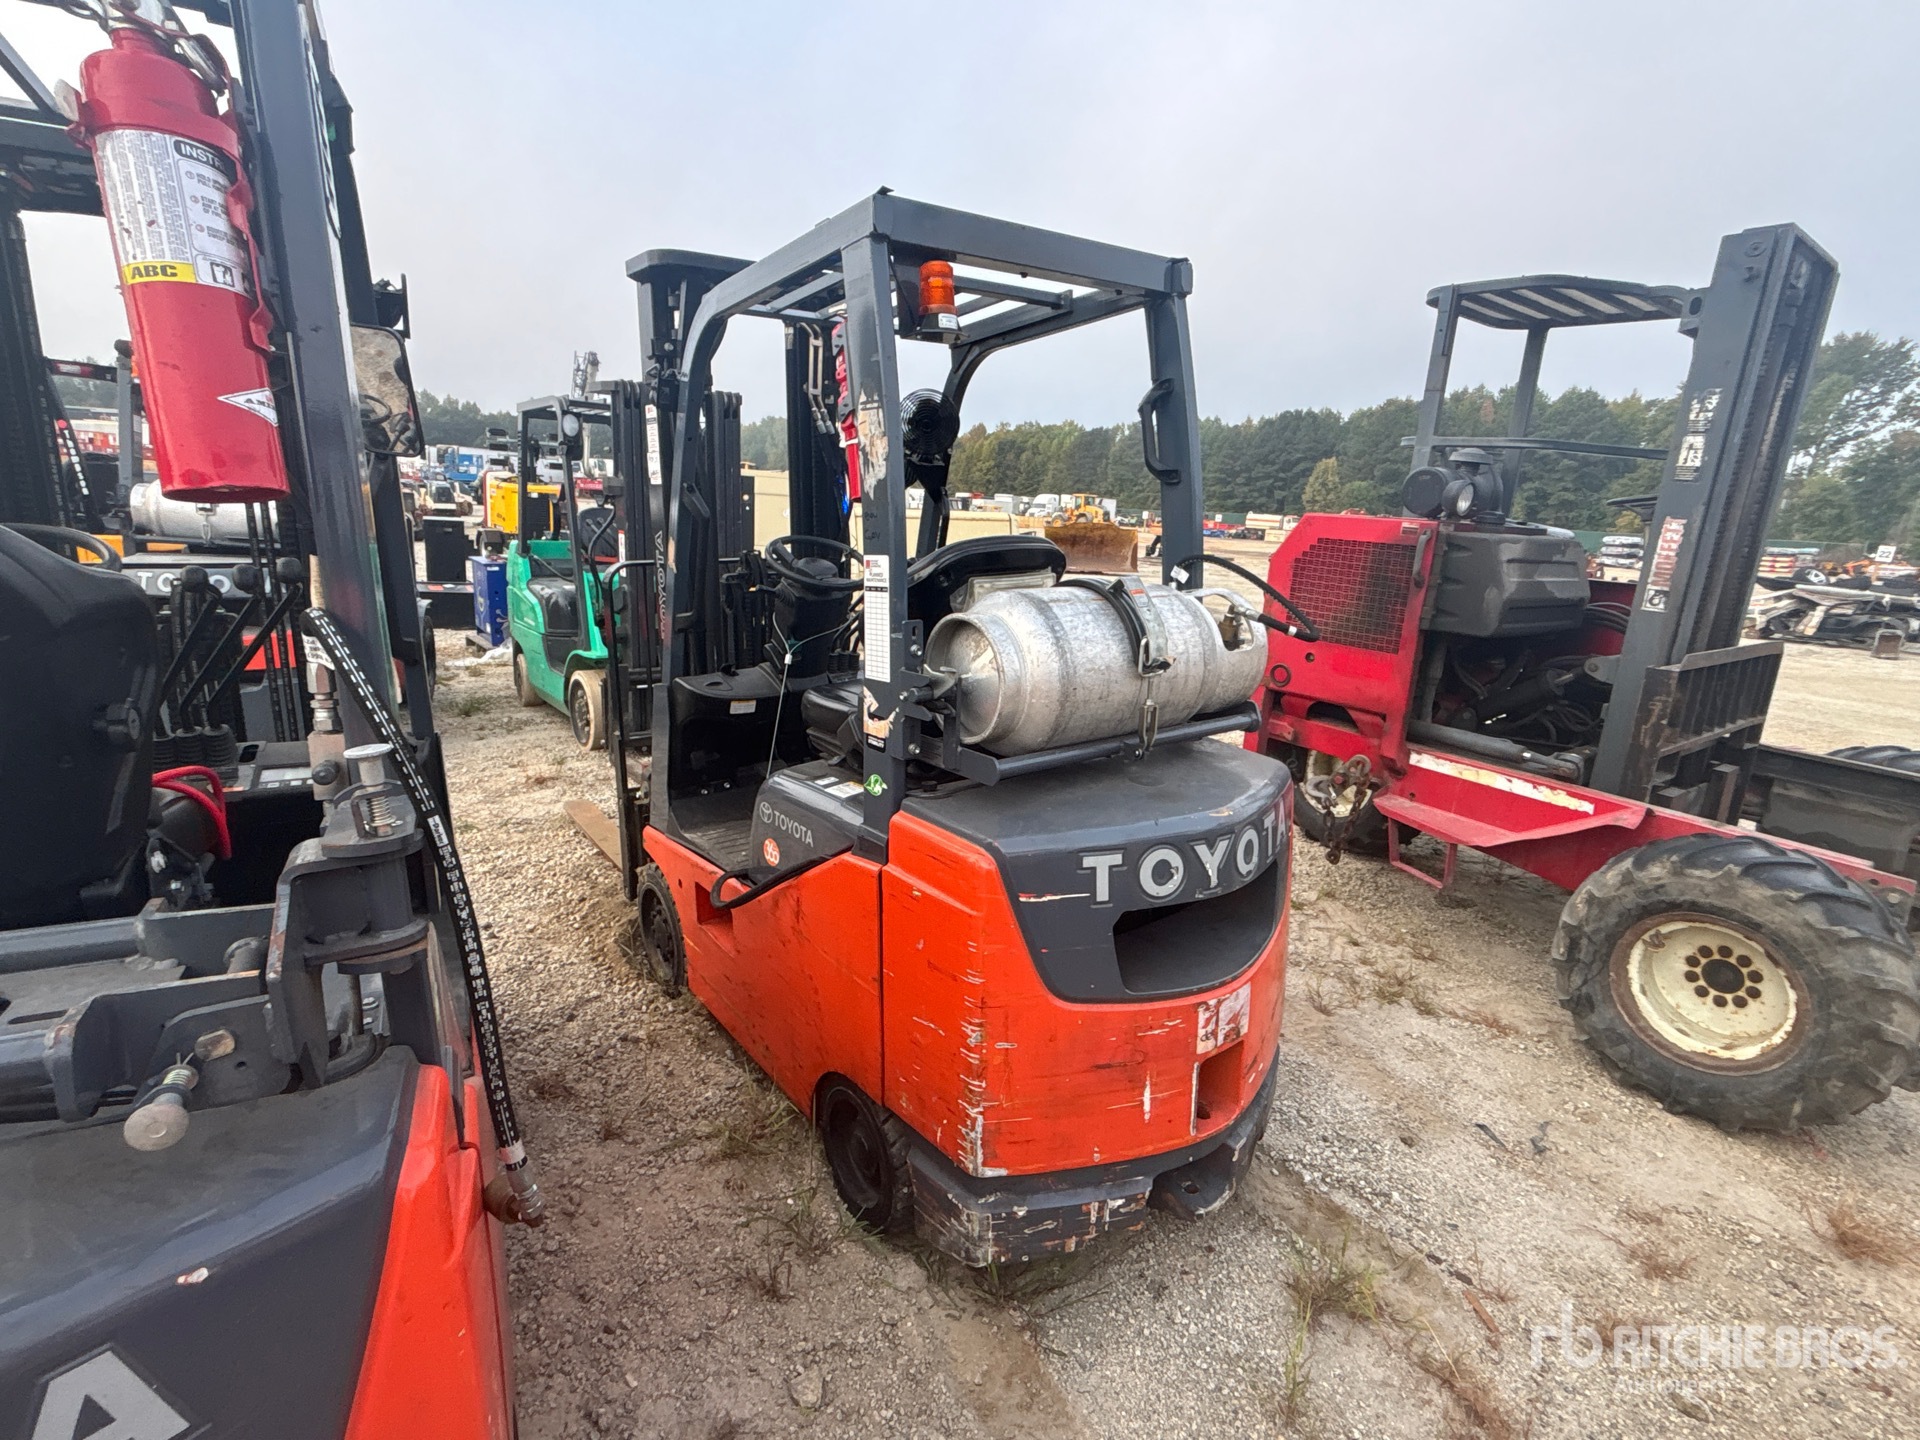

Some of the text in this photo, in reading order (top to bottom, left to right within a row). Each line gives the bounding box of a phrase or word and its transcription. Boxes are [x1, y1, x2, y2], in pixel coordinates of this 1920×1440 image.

[131, 264, 178, 279] ABC
[774, 811, 814, 847] TOYOTA
[1082, 798, 1287, 902] TOYOTA
